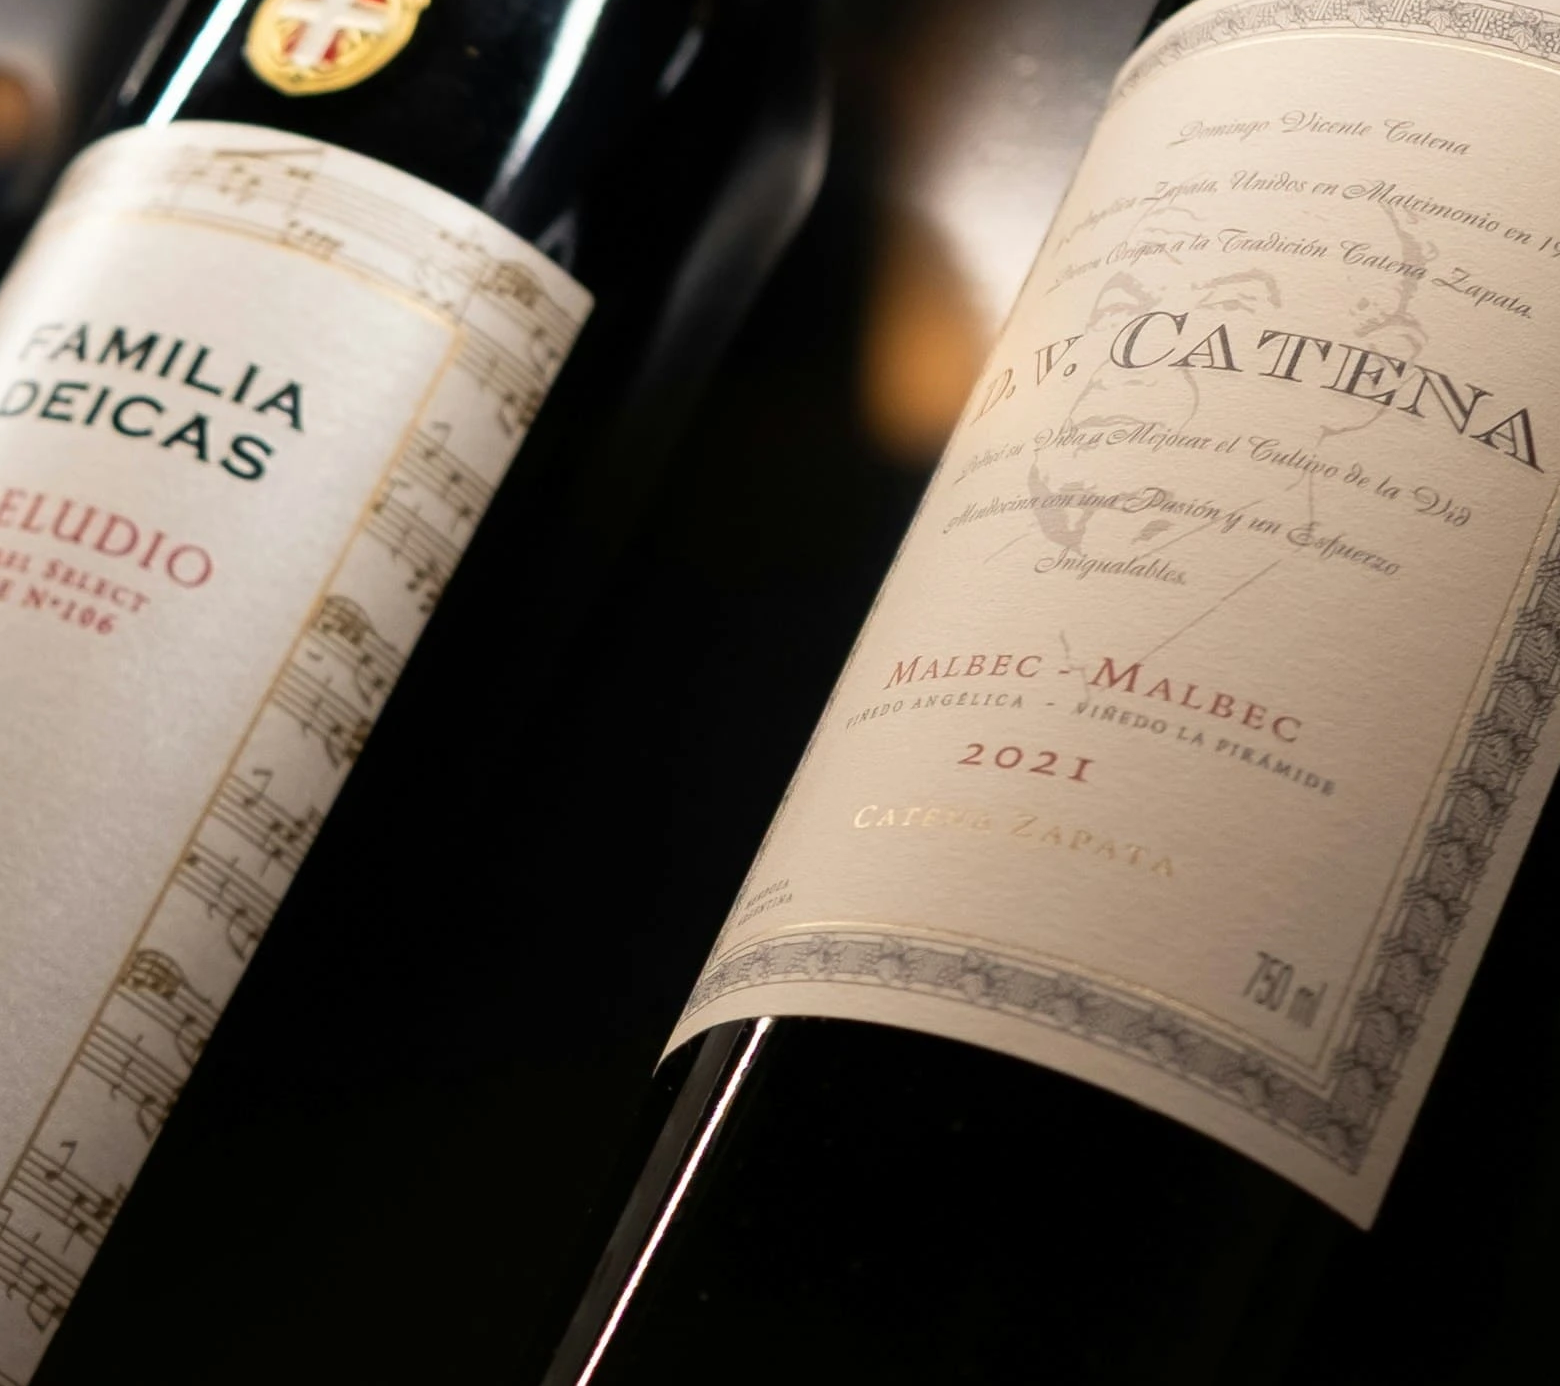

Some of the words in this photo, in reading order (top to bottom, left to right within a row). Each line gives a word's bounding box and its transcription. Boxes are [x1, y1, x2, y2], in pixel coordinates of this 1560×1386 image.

[1166, 119, 1271, 148] Domingo
[1280, 110, 1373, 137] Vicente
[1384, 118, 1474, 155] Catena
[1231, 170, 1307, 193] Unidos
[1311, 183, 1339, 195] en
[1342, 180, 1500, 233] Matrimonio
[1504, 227, 1532, 245] en
[1172, 240, 1185, 253] a
[1189, 233, 1211, 251] la
[1217, 228, 1328, 258] Tradición
[1341, 240, 1427, 279] Catena
[1432, 267, 1533, 319] Zapata.
[19, 322, 306, 433] FAMILIA
[1034, 335, 1084, 385] V.
[1109, 311, 1545, 473] CATENA
[0, 378, 275, 482] DEICAS
[1106, 423, 1214, 451] Mejorar
[1214, 436, 1241, 454] el
[1249, 435, 1339, 479] Cultivo
[1343, 462, 1369, 489] de
[1376, 476, 1401, 500] la
[1411, 485, 1473, 527] Vid
[1034, 548, 1186, 585] Inigualables.
[1079, 493, 1119, 509] una
[1121, 486, 1221, 519] Pasión
[1224, 512, 1243, 535] y
[1249, 518, 1283, 535] un
[1287, 522, 1401, 576] Esfuerzo
[42, 558, 152, 614] SELECT
[883, 654, 1042, 690] MALBEC
[1088, 657, 1302, 743] MALBEC
[910, 691, 1024, 710] ANGÉLICA
[1177, 726, 1204, 746] LA
[1215, 738, 1337, 797] PIRÁMIDE
[958, 743, 1096, 782] 2021
[1243, 951, 1294, 1012] 750
